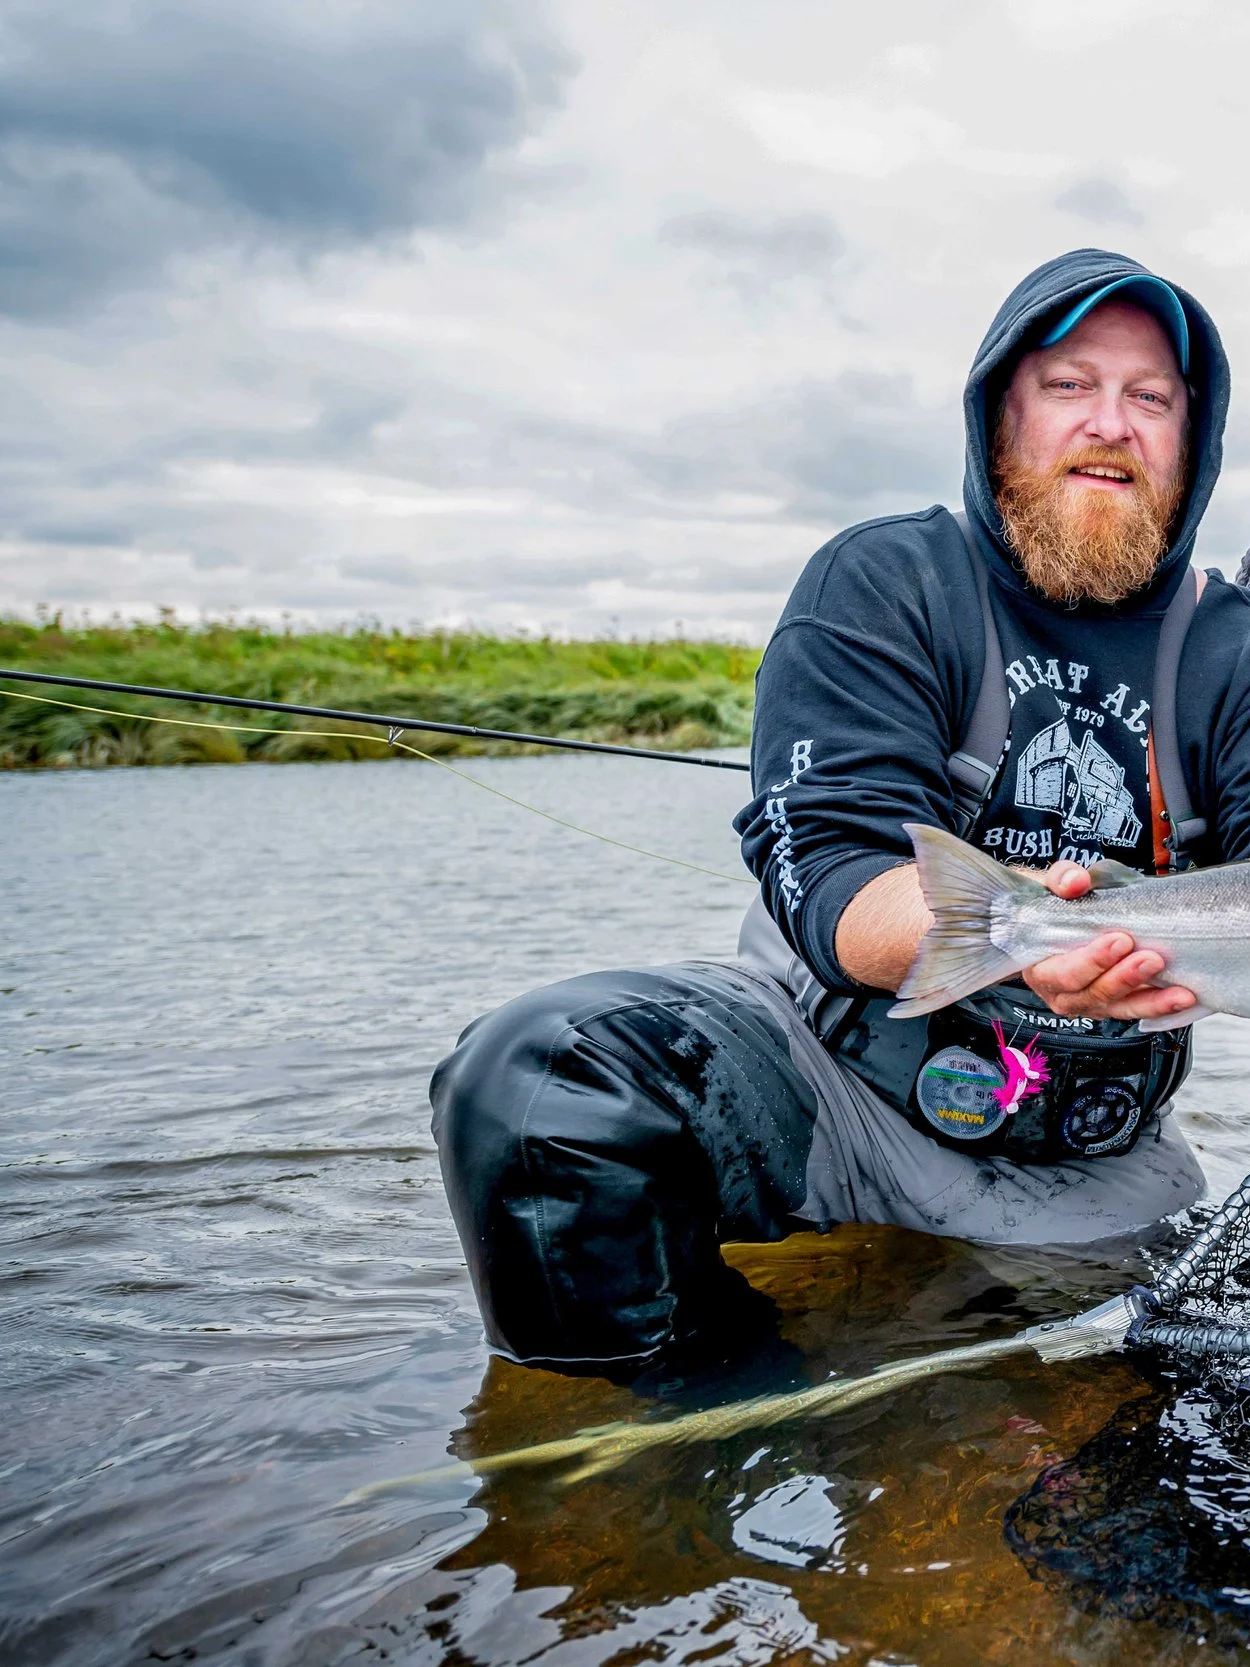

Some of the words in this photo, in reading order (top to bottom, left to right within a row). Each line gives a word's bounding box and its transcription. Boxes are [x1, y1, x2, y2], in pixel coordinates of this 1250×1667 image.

[1074, 706, 1104, 728] 1979
[982, 826, 1054, 858] BUSH
[1013, 1006, 1094, 1030] SIMMS
[938, 1108, 985, 1125] MAXIMA
